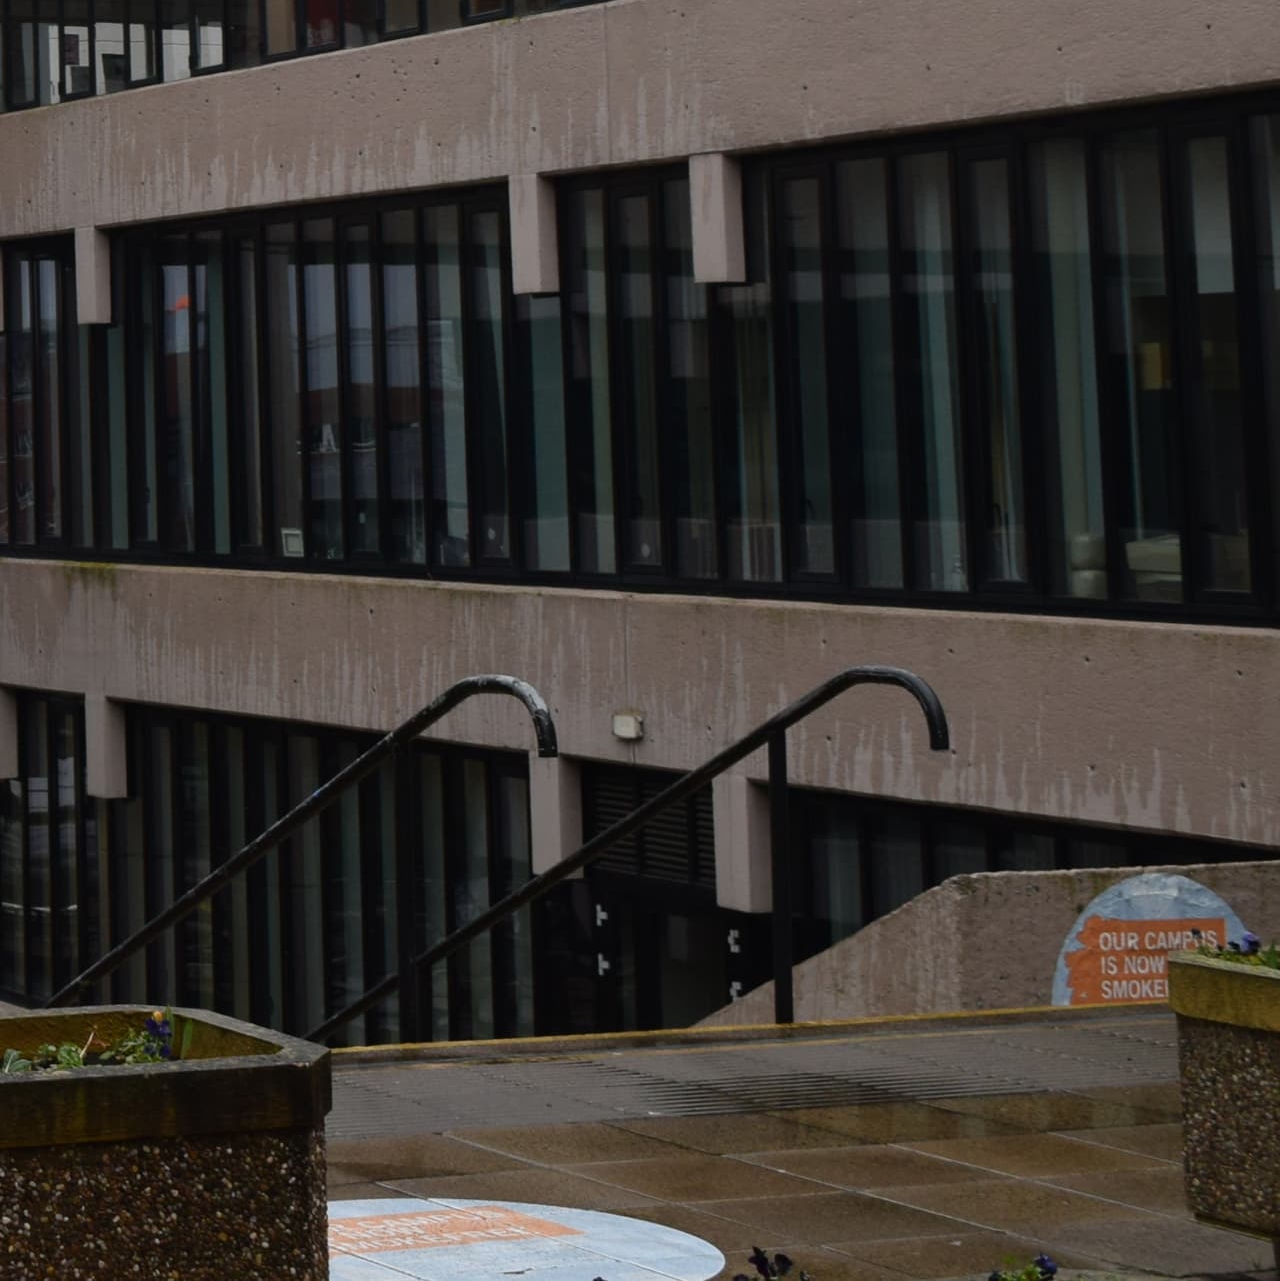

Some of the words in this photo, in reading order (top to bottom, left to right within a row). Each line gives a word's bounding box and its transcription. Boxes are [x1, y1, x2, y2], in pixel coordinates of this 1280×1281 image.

[1099, 931, 1139, 951] OUR
[1100, 956, 1118, 975] IS
[1124, 954, 1165, 975] NOW
[1101, 979, 1168, 1000] SMOKE
